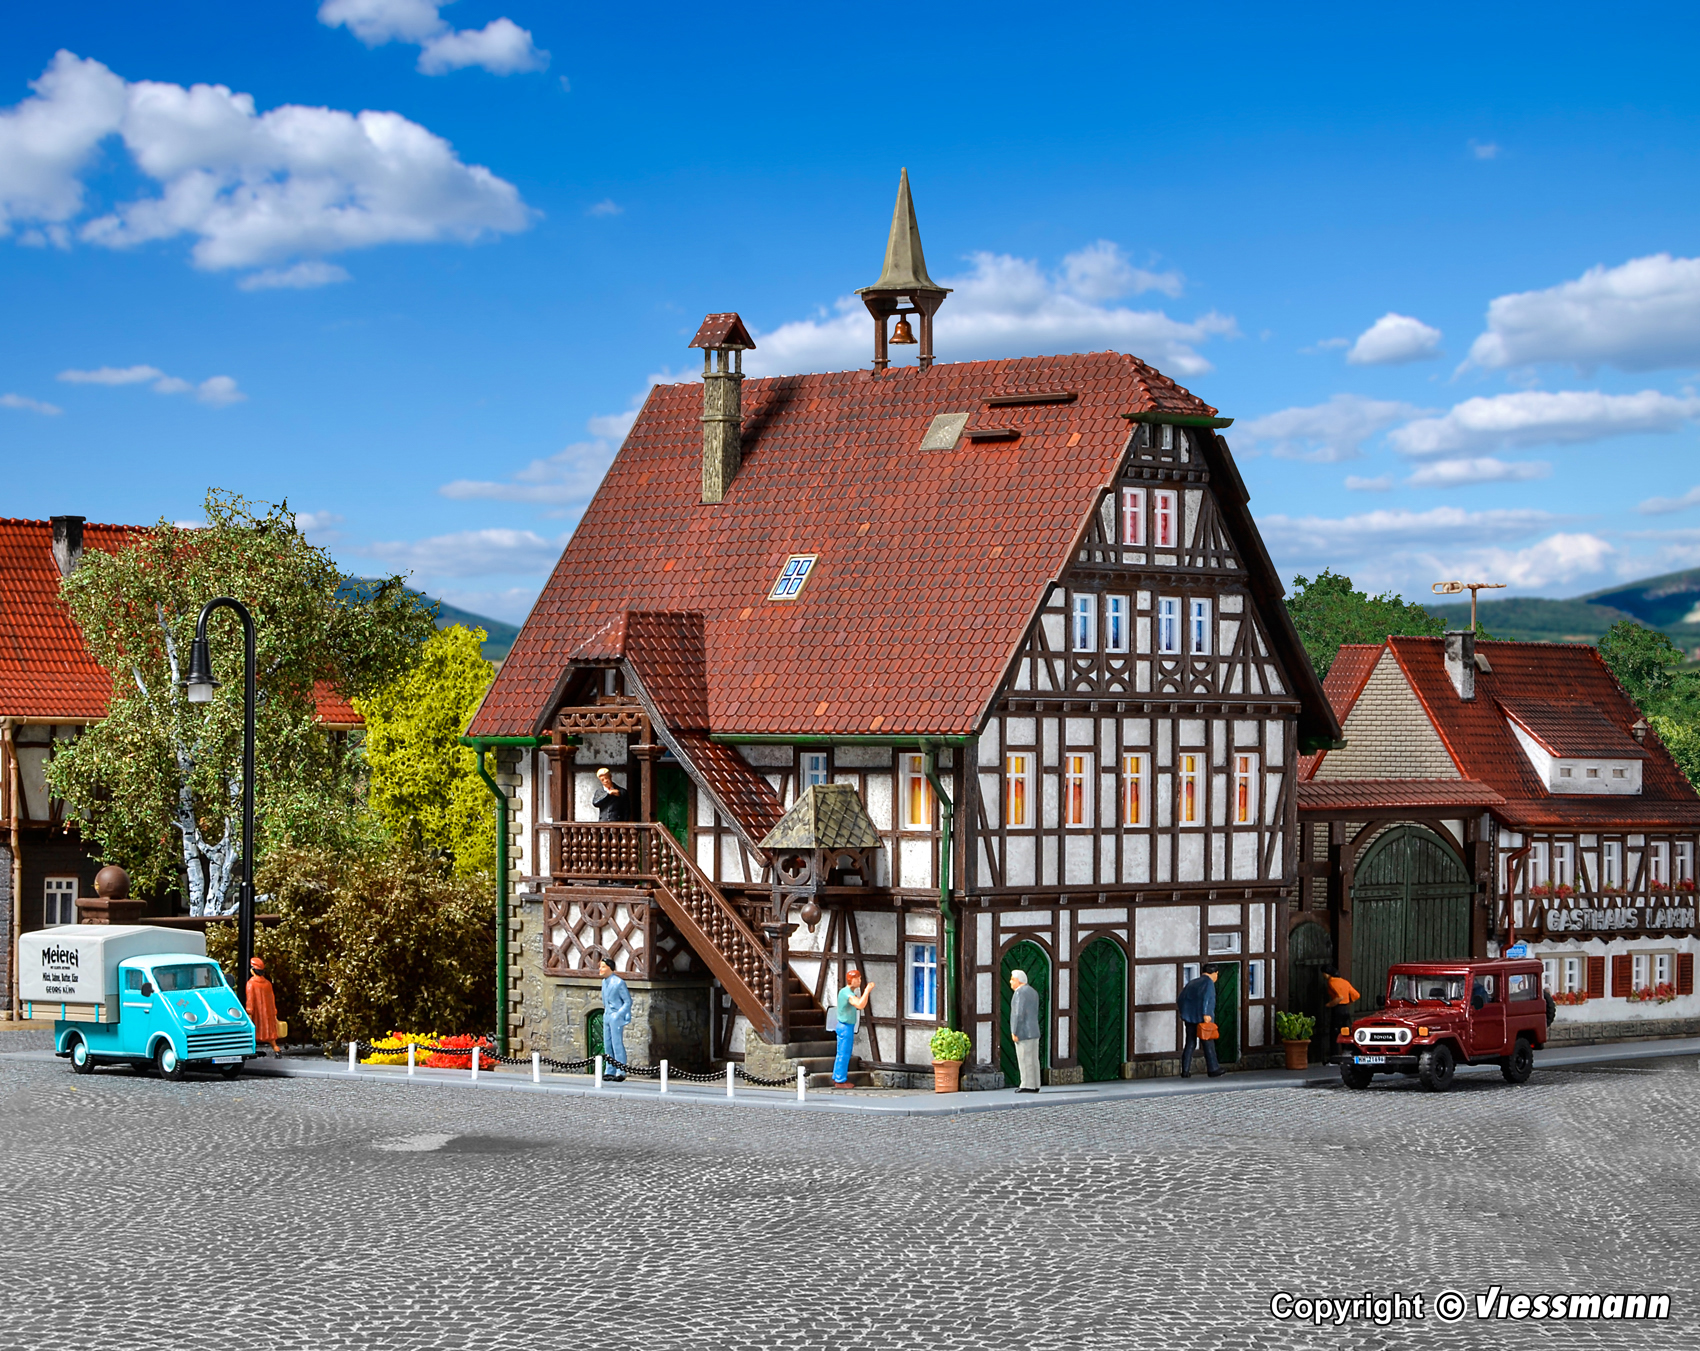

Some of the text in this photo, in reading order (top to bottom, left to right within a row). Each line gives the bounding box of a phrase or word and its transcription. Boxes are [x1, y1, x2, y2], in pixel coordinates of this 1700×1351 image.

[1547, 907, 1695, 931] GASTHAUS LAMM
[42, 944, 79, 968] Meierei
